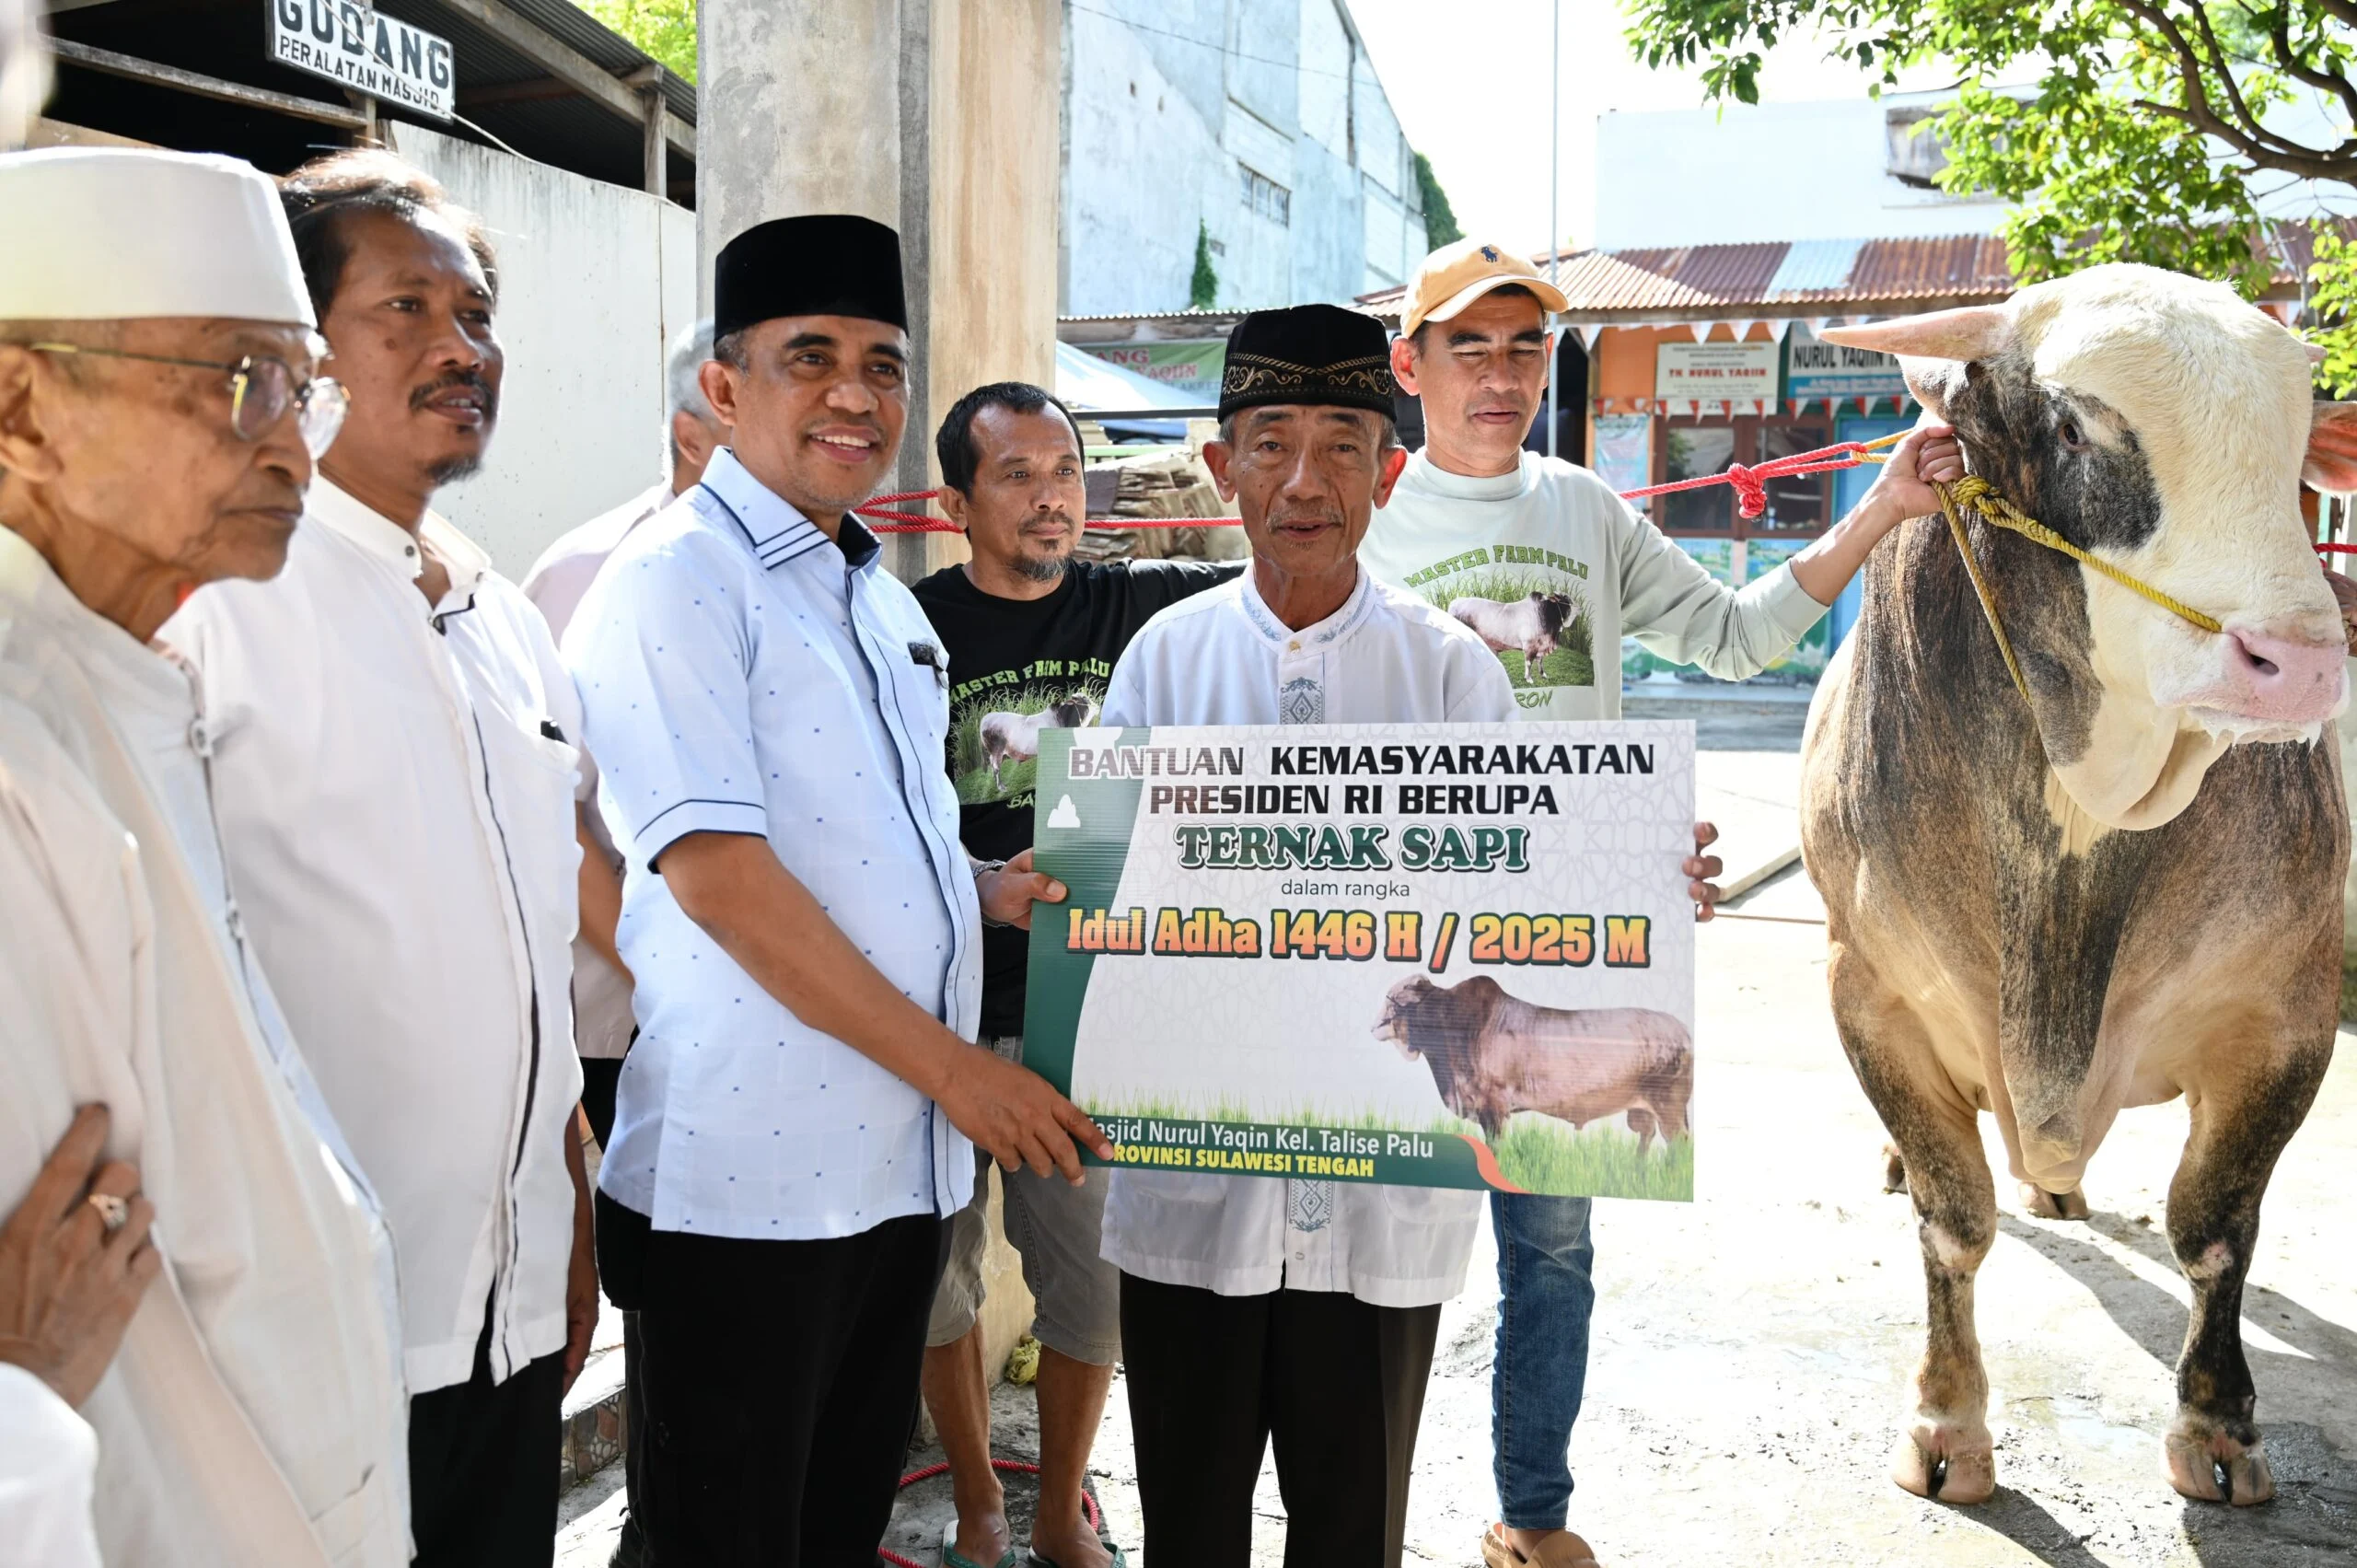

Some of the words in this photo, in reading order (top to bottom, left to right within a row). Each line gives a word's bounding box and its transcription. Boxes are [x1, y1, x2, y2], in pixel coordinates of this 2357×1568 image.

[278, 0, 449, 89] GUDANG
[382, 74, 440, 110] MASJID
[1794, 345, 1836, 367] NURUL
[1403, 548, 1490, 588] MASTER
[1492, 544, 1545, 563] FARM
[1546, 550, 1589, 580] PALU
[1515, 690, 1553, 709] RON
[1069, 746, 1244, 778] BANTUAN
[1271, 744, 1655, 775] KEMASYARAKATAN
[1150, 784, 1329, 814] PRESIDEN
[1344, 784, 1382, 814] RI
[1399, 784, 1560, 814] BERUPA
[1174, 823, 1392, 871] TERNAK
[1399, 824, 1530, 872] SAPI
[1281, 878, 1339, 895] dalam
[1345, 880, 1410, 900] rangka
[1066, 907, 1145, 955] Idul
[1152, 906, 1261, 958] Adha
[1270, 909, 1376, 960] 1446
[1384, 911, 1422, 962] H
[1428, 912, 1460, 974] /
[1469, 912, 1595, 968] 2025
[1604, 914, 1651, 969] M
[1089, 1117, 1142, 1144] asjid
[1149, 1121, 1206, 1145] Nurul
[1212, 1124, 1269, 1154] Yaqin
[1275, 1128, 1315, 1151] Kel.
[1319, 1130, 1379, 1155] Talise
[1387, 1133, 1434, 1158] Palu
[1113, 1144, 1190, 1167] ROVINSI
[1195, 1148, 1291, 1172] SULAWESI
[1295, 1155, 1374, 1178] TENGAH
